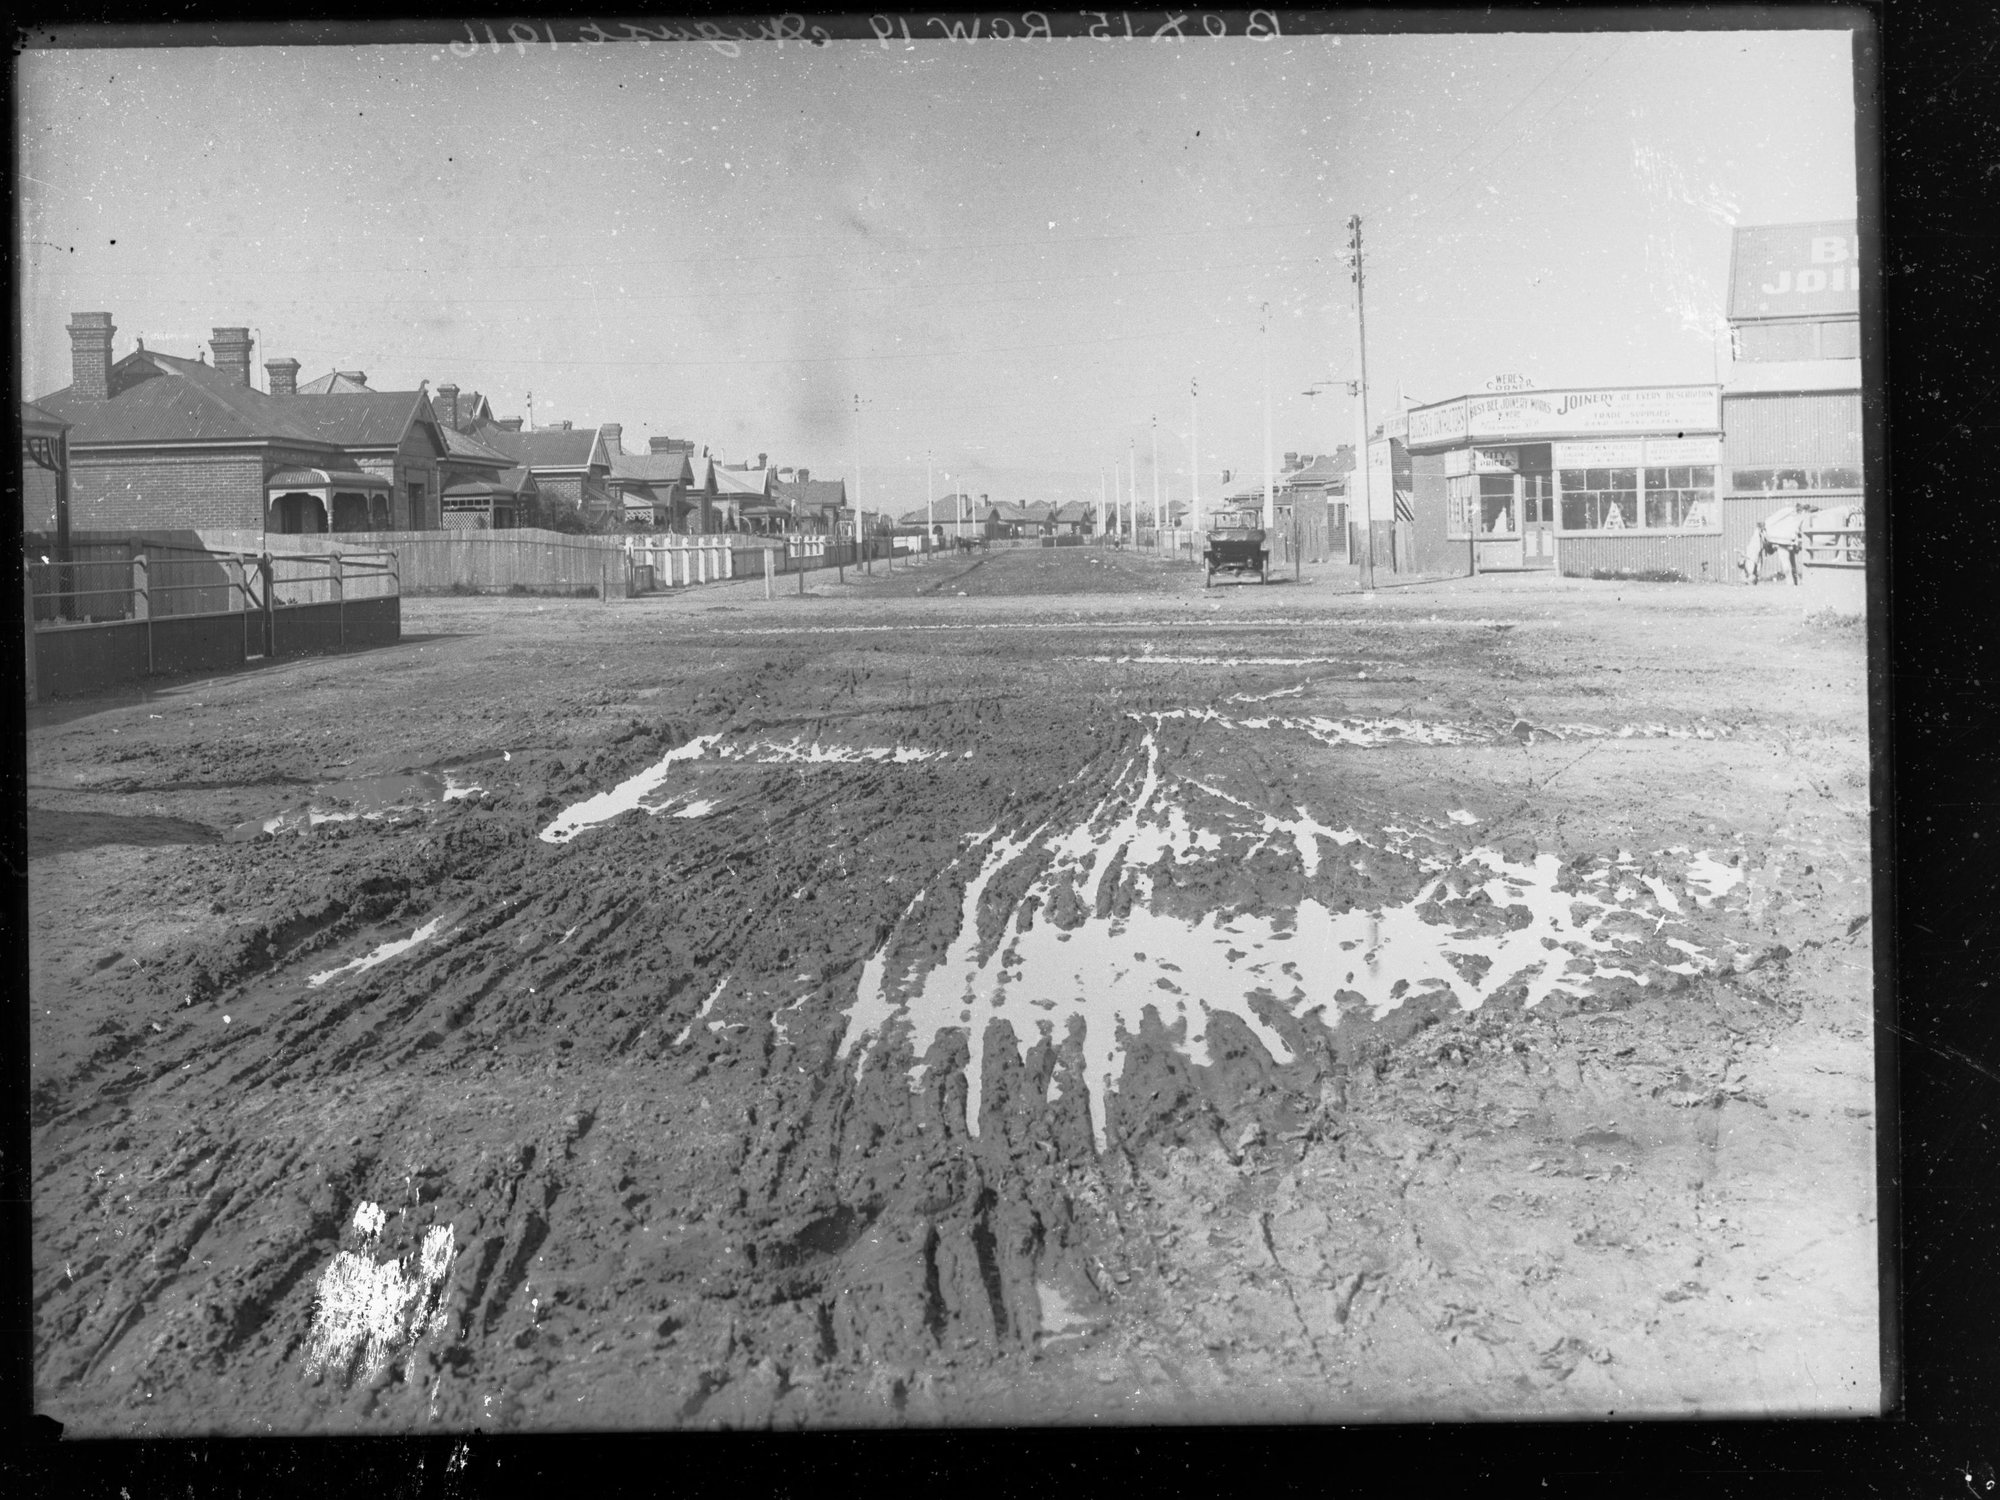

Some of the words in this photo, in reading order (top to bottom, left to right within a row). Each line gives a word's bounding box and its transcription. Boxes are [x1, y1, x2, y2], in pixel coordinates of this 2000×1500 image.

[1811, 234, 1859, 264] B
[1486, 378, 1535, 391] CORNER
[1557, 394, 1614, 416] JOINERY
[1636, 392, 1661, 401] EVERY
[1666, 391, 1714, 401] DESCRIPTION
[1630, 410, 1671, 418] SUPPLIED
[1483, 449, 1509, 459] CITY
